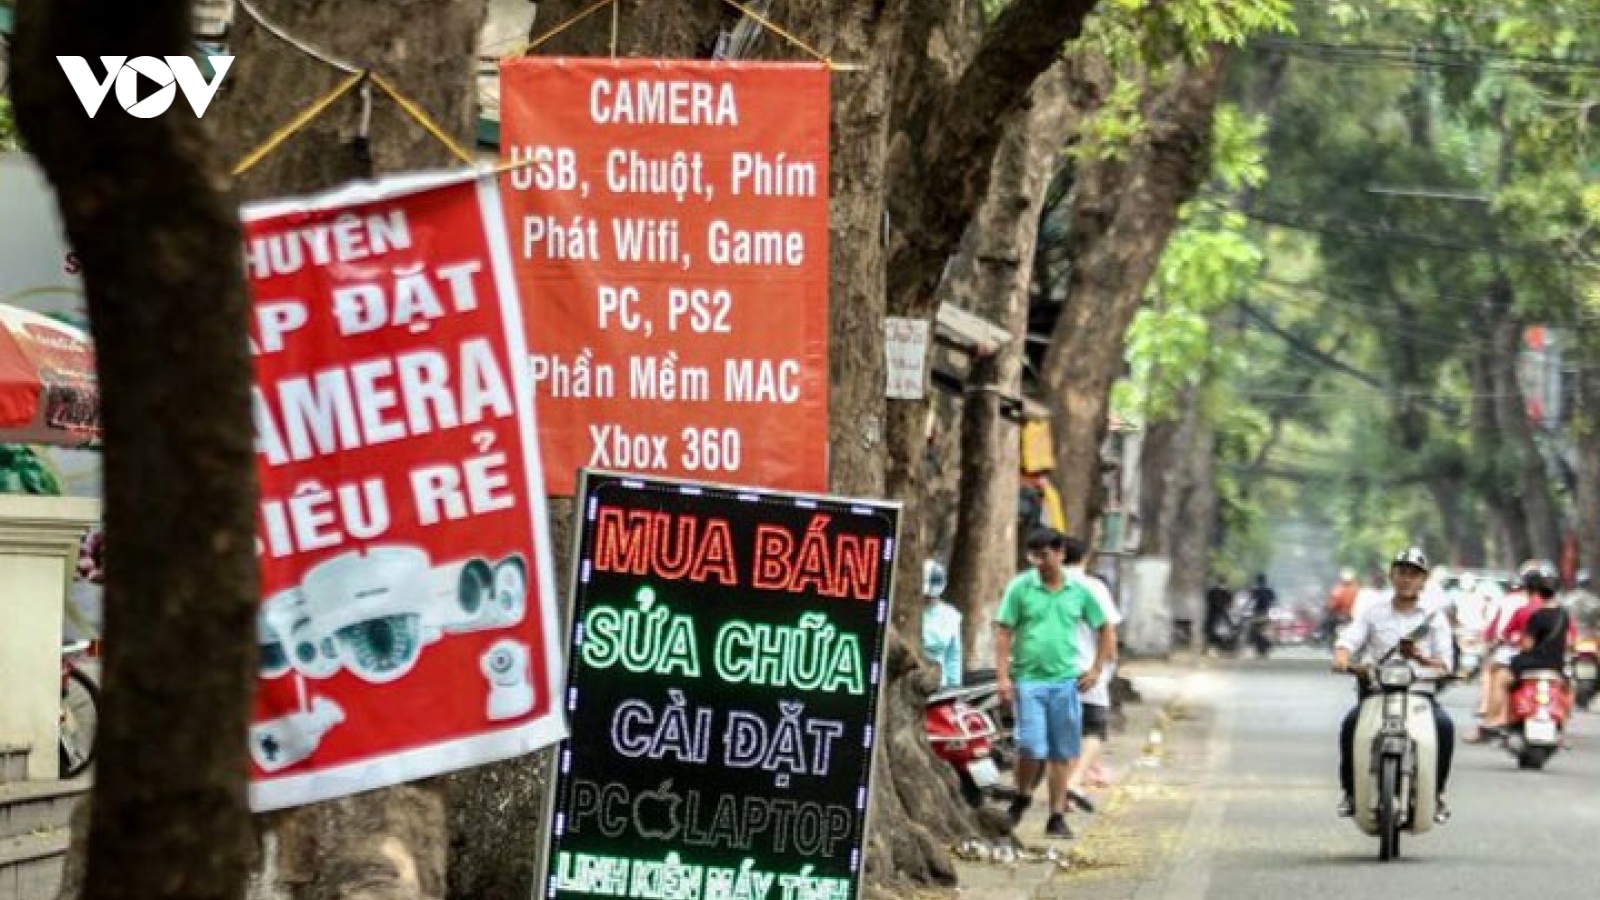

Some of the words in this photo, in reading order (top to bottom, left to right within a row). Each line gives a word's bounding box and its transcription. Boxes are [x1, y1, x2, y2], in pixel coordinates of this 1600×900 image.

[589, 78, 738, 126] CAMERA
[510, 145, 590, 198] USB,
[606, 149, 714, 203] Chuột,
[731, 152, 817, 198] Phím
[244, 208, 412, 280] HUYÊN
[523, 215, 600, 261] Phát
[612, 217, 692, 271] Wifi,
[707, 220, 805, 266] Game
[332, 260, 482, 335] ĐẶT
[598, 286, 652, 338] PC,
[668, 288, 732, 333] PS2
[529, 347, 615, 399] Phần
[629, 349, 711, 402] Mềm
[724, 358, 801, 403] MAC
[589, 424, 669, 470] Xbox
[681, 427, 742, 471] 360
[255, 477, 392, 558] IÊU
[408, 430, 516, 527] RẺ
[595, 505, 738, 586] MUA
[752, 515, 881, 601] BÁN
[582, 586, 701, 677] SỬA
[714, 612, 864, 695] CHỮA
[611, 688, 712, 764] CÀI
[723, 701, 844, 788] ĐẶT
[569, 779, 630, 839] PC
[683, 790, 851, 857] LAPTOP
